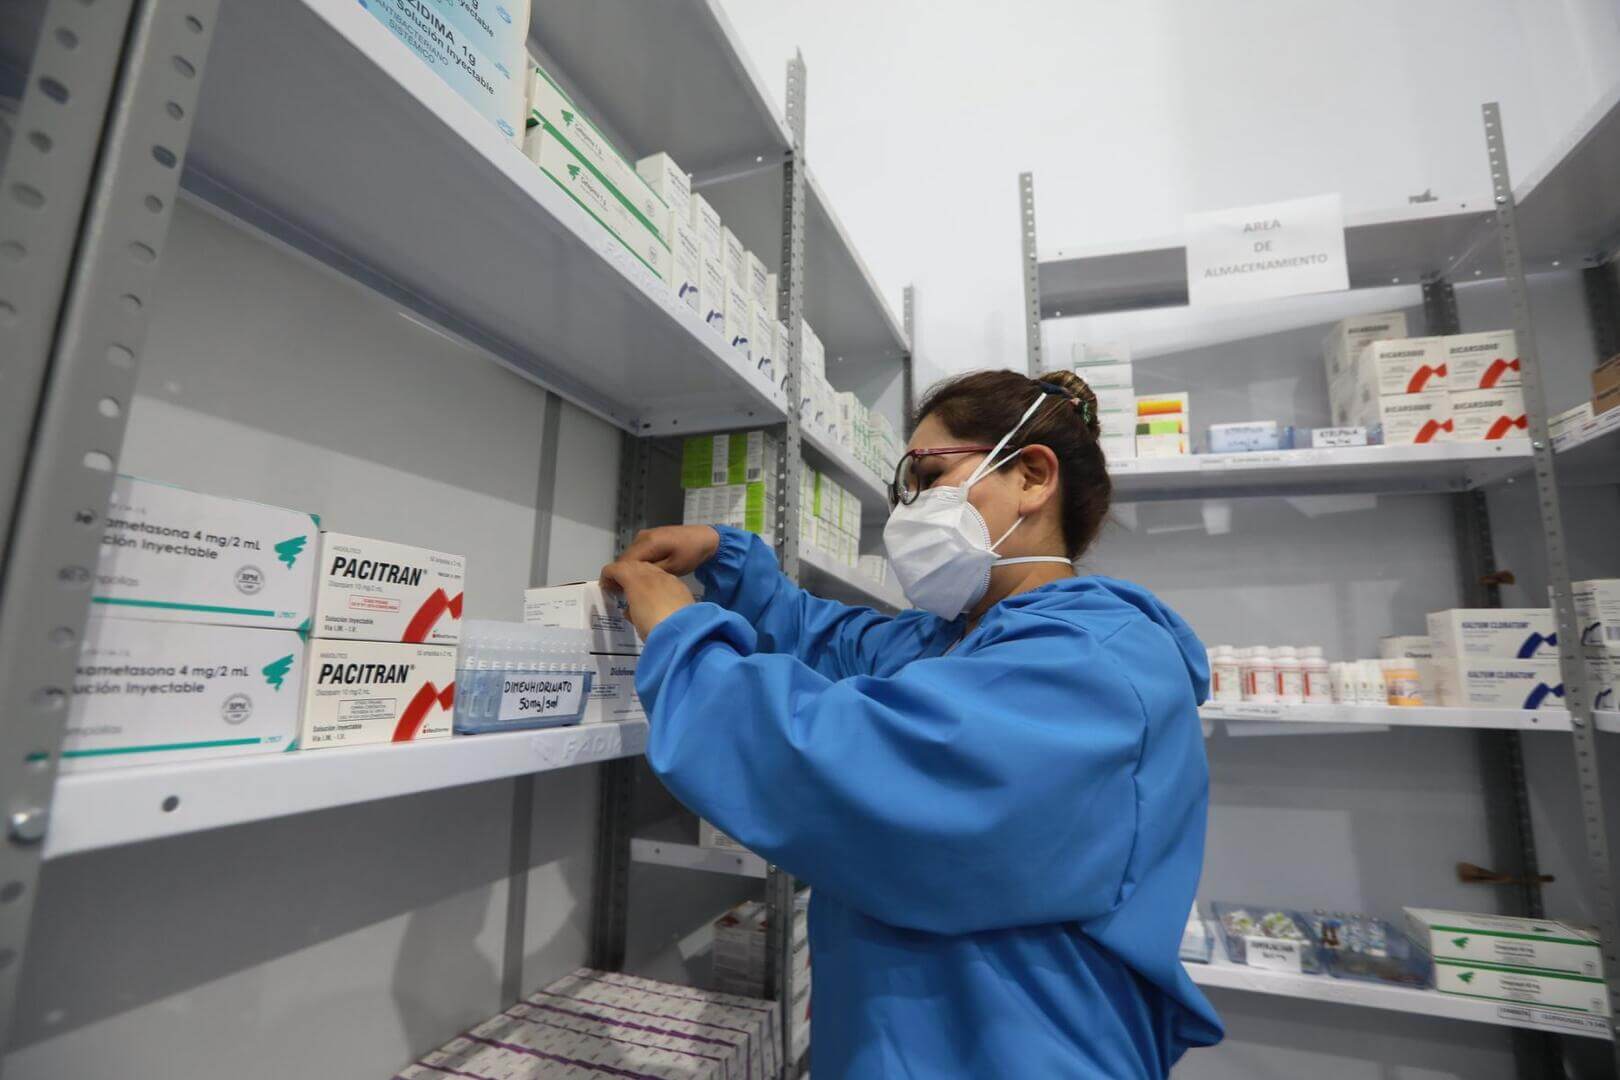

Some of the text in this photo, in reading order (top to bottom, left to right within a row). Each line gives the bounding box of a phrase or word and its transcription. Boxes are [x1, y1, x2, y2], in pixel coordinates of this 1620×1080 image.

[446, 44, 495, 95] Inyectable
[1243, 219, 1282, 233] AREA
[1254, 241, 1273, 253] DE
[1204, 253, 1328, 278] ALMACENAMIENTO
[141, 536, 219, 560] Inyectable
[193, 530, 203, 541] 4
[205, 533, 241, 548] mg/2
[243, 539, 261, 551] mL
[330, 556, 422, 587] PACITRAN
[179, 665, 189, 676] 4
[192, 665, 227, 679] mg/2
[231, 665, 249, 677] mL
[317, 664, 410, 685] PACITRAN
[126, 682, 205, 696] Inyectable
[504, 680, 572, 694] DIMENHIDRINATO
